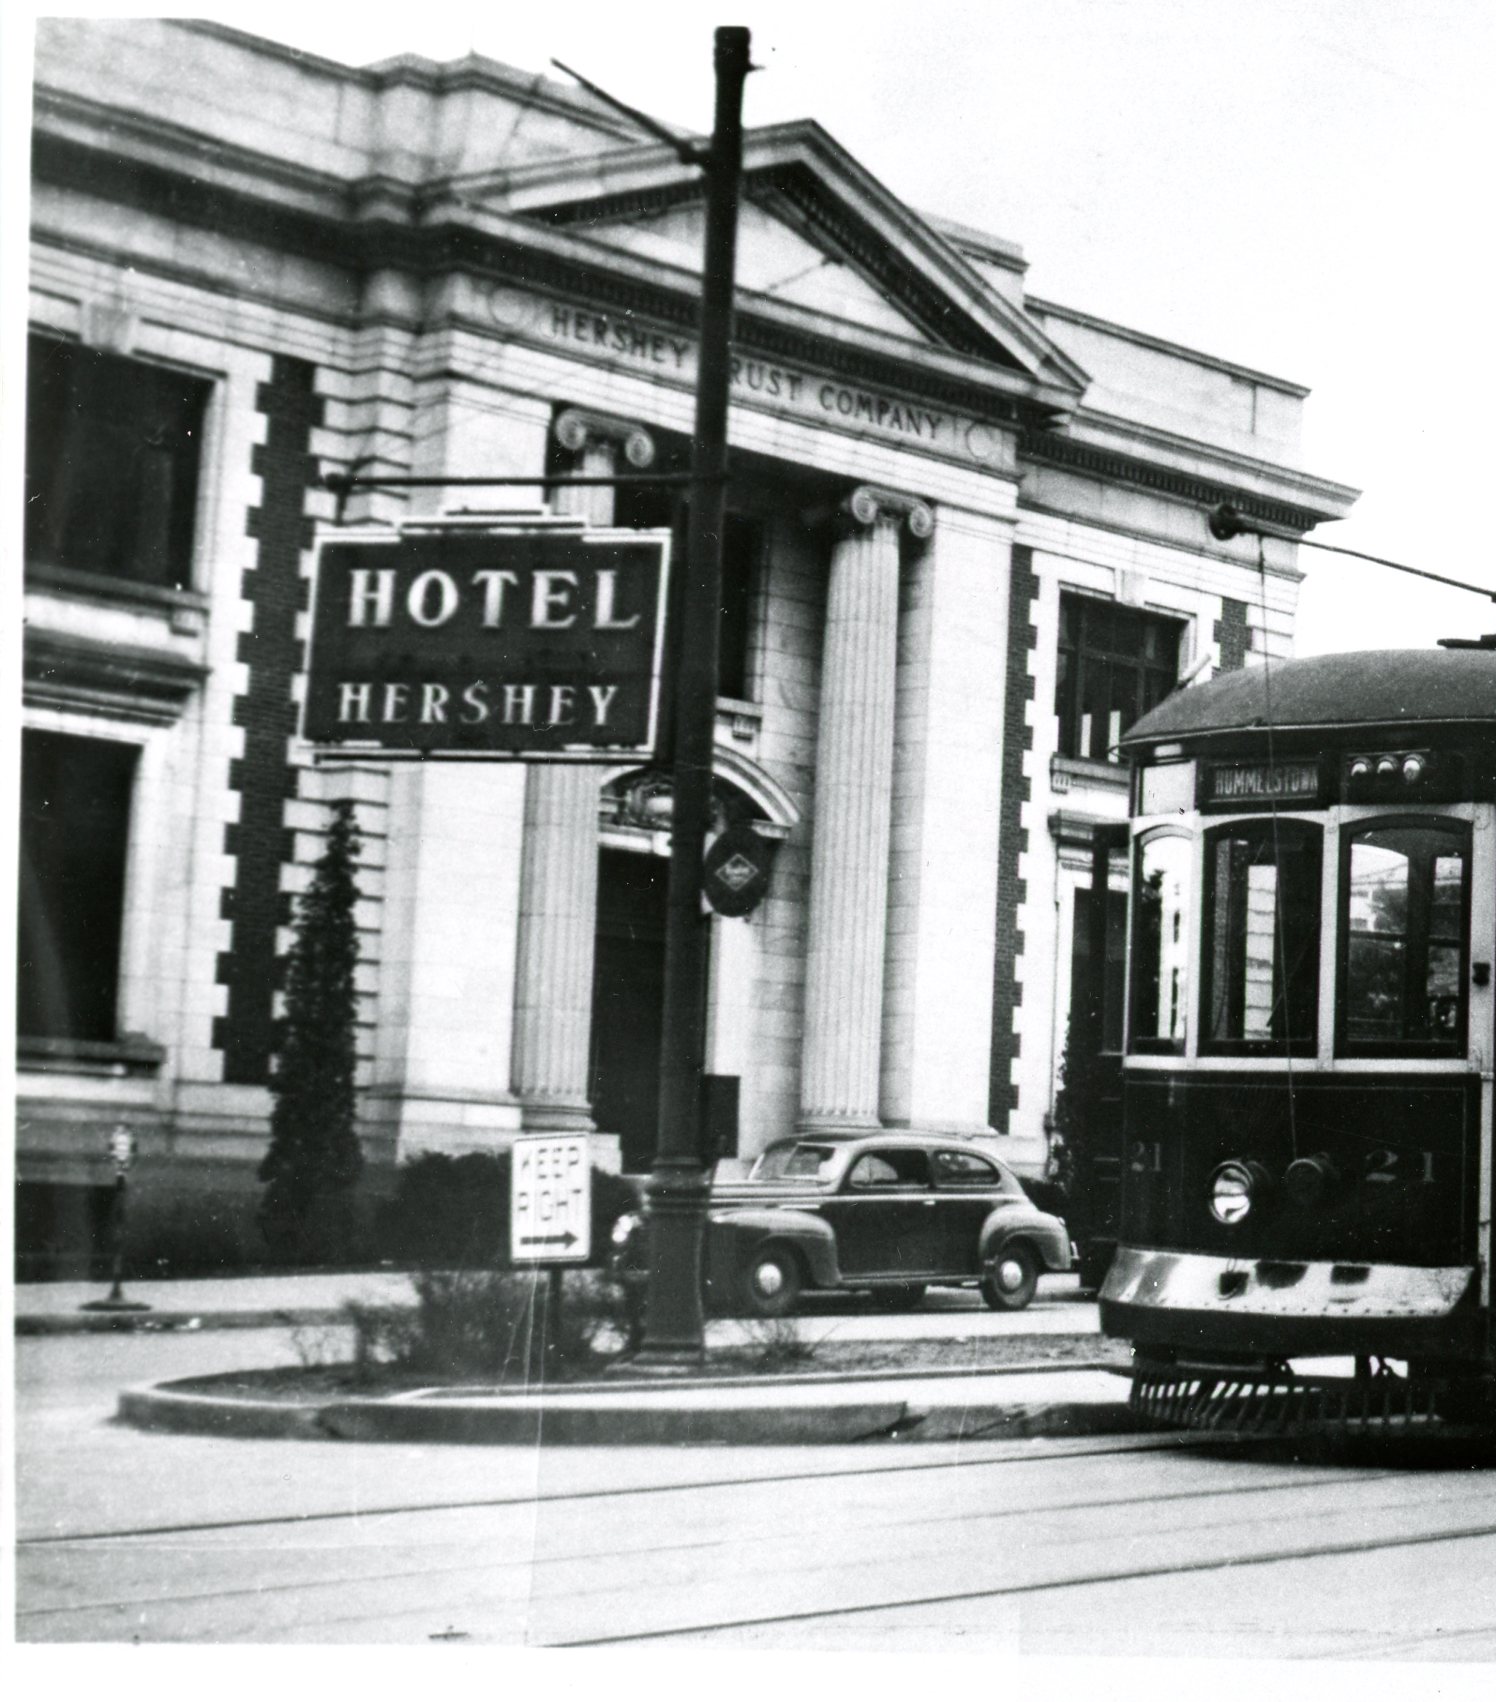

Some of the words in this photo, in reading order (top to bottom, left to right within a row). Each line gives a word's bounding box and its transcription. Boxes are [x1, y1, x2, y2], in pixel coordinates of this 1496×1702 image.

[552, 307, 690, 369] HERSHEY
[730, 354, 803, 401] RUST
[820, 385, 941, 439] COMPANY
[348, 568, 640, 629] HOTEL
[336, 682, 618, 725] HERSHEY
[1130, 1142, 1162, 1173] 21
[1364, 1150, 1436, 1184] 21
